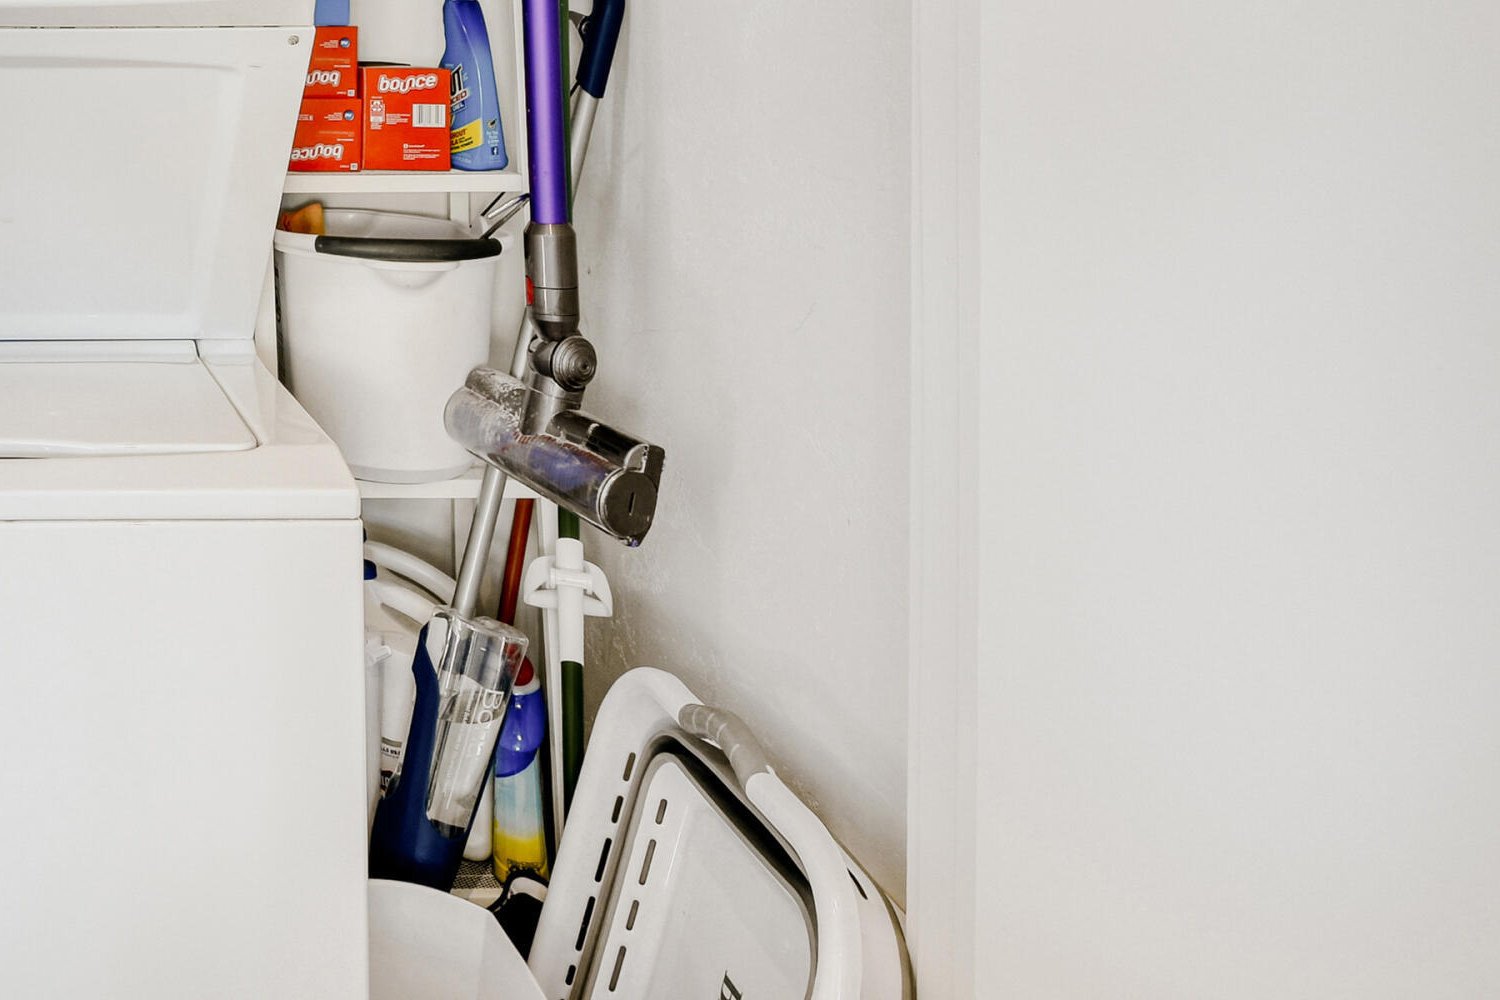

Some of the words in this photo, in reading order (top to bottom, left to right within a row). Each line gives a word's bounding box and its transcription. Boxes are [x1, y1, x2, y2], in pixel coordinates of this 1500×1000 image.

[305, 69, 341, 87] boun
[378, 73, 439, 94] bounce
[291, 142, 344, 161] bounce
